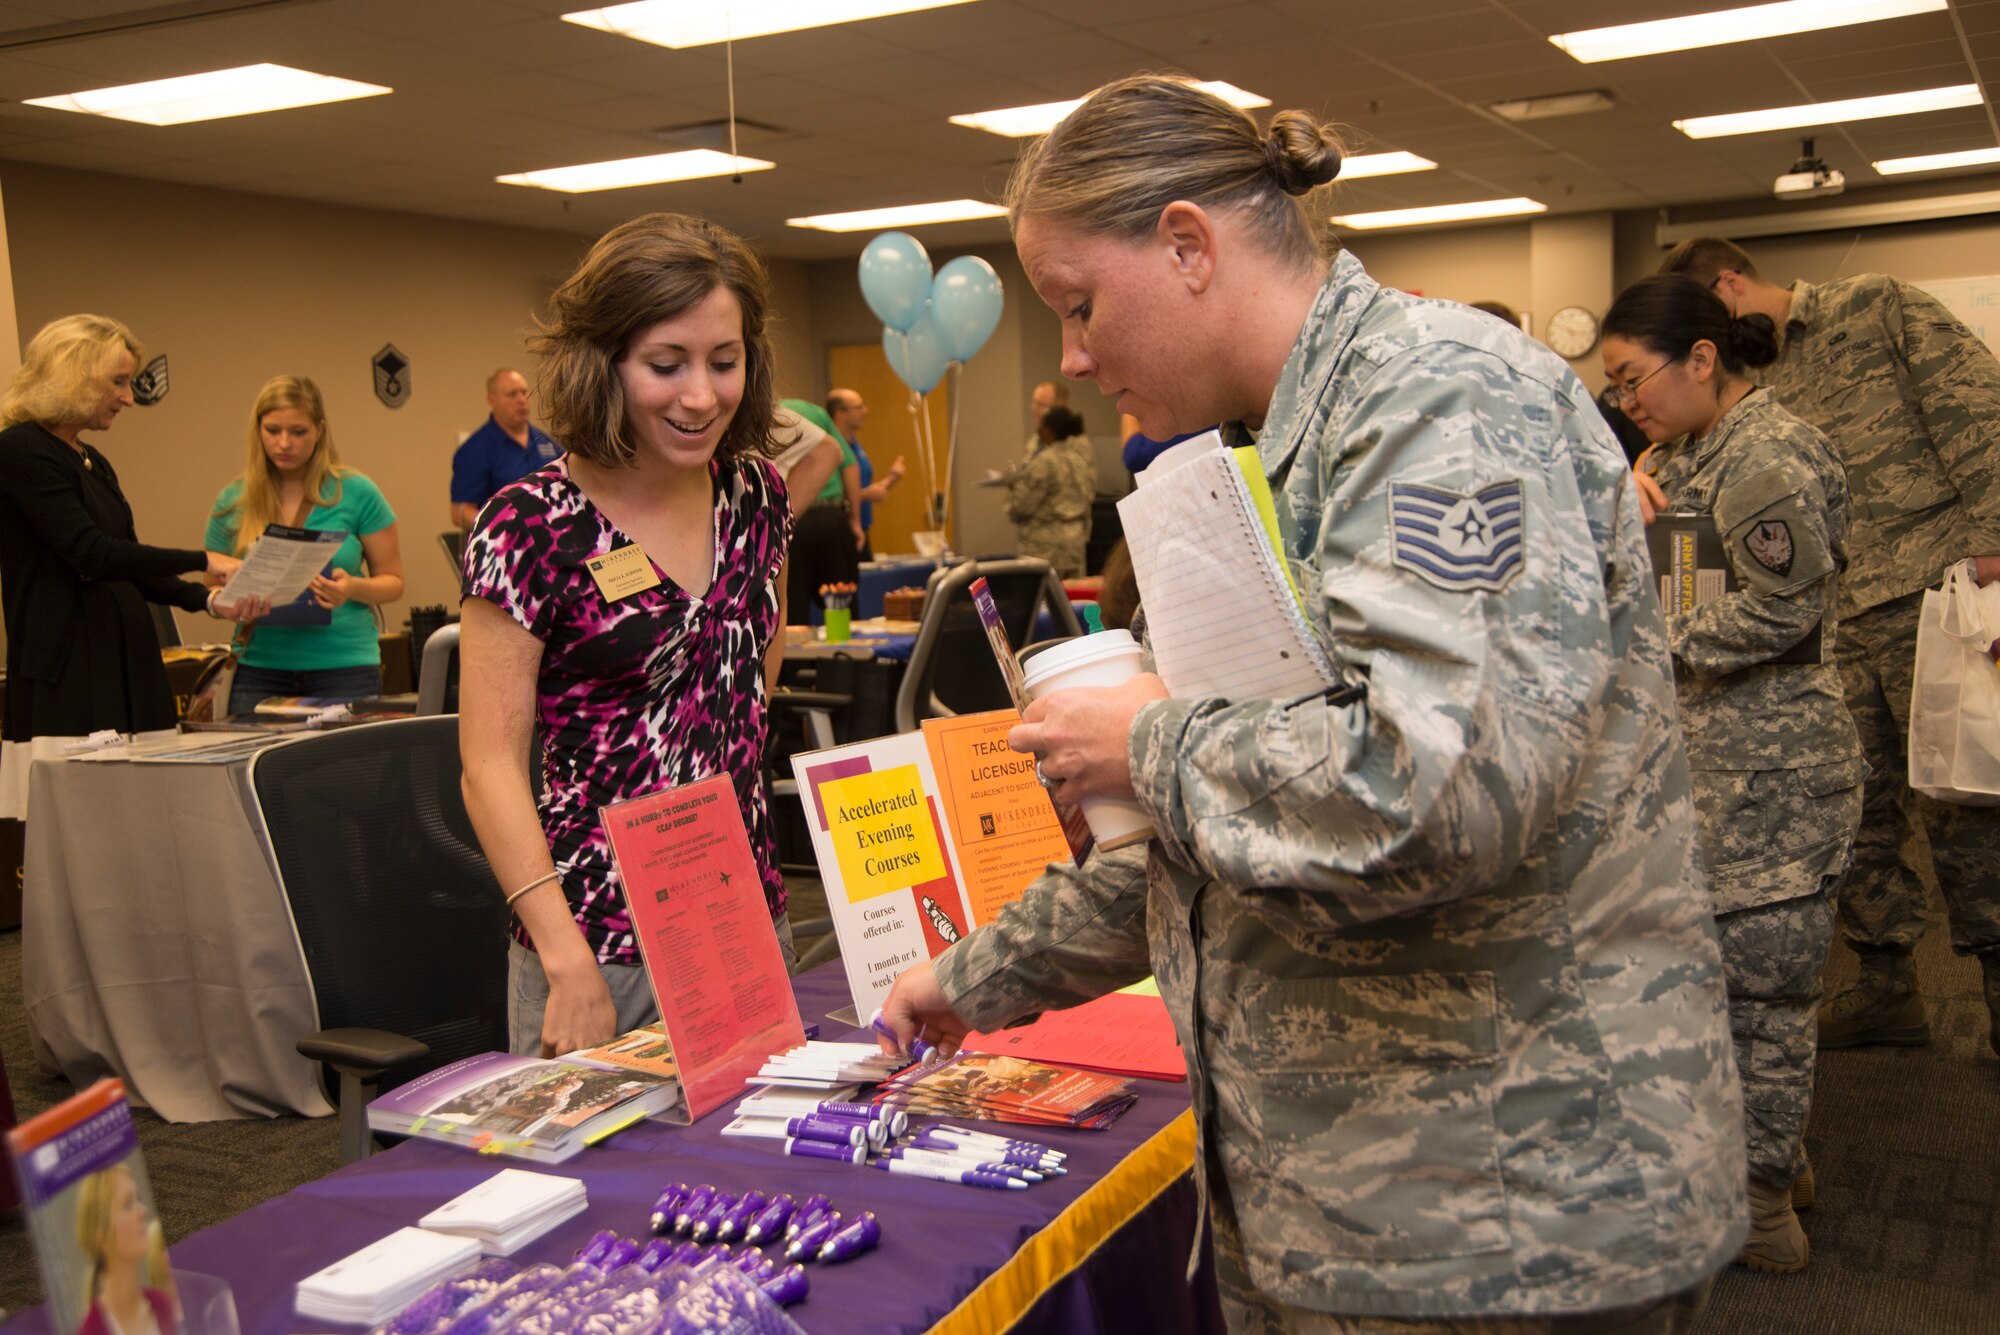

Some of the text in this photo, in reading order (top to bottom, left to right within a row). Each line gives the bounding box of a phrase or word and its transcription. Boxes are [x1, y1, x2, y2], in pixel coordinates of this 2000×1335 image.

[1681, 486, 1710, 500] ARMY
[1681, 535, 1694, 571] ARMY
[983, 725, 998, 734] EARN
[972, 739, 1010, 756] TEAC
[971, 760, 1035, 781] LICENSUR
[970, 781, 1037, 800] ADJACENT TO SCOTT
[635, 818, 640, 827] A
[640, 810, 662, 825] HURRY
[663, 807, 671, 818] TO
[672, 799, 702, 815] COMPLETE
[702, 792, 718, 804] YOUR
[838, 788, 918, 824] Accelerated
[656, 821, 673, 834] CCAF
[855, 822, 915, 849] Evening
[864, 850, 921, 877] Courses
[978, 864, 999, 875] EVENING
[1000, 860, 1021, 870] COURSES
[1023, 856, 1045, 865] beginning
[980, 875, 998, 884] Courses
[1017, 868, 1029, 876] Scott
[984, 885, 1004, 893] Lebanon
[984, 895, 999, 903] Course
[1000, 891, 1015, 899] length
[863, 905, 896, 922] Courses
[863, 919, 905, 940] offered in:
[867, 947, 918, 974] 1 month or 6
[871, 974, 893, 989] week
